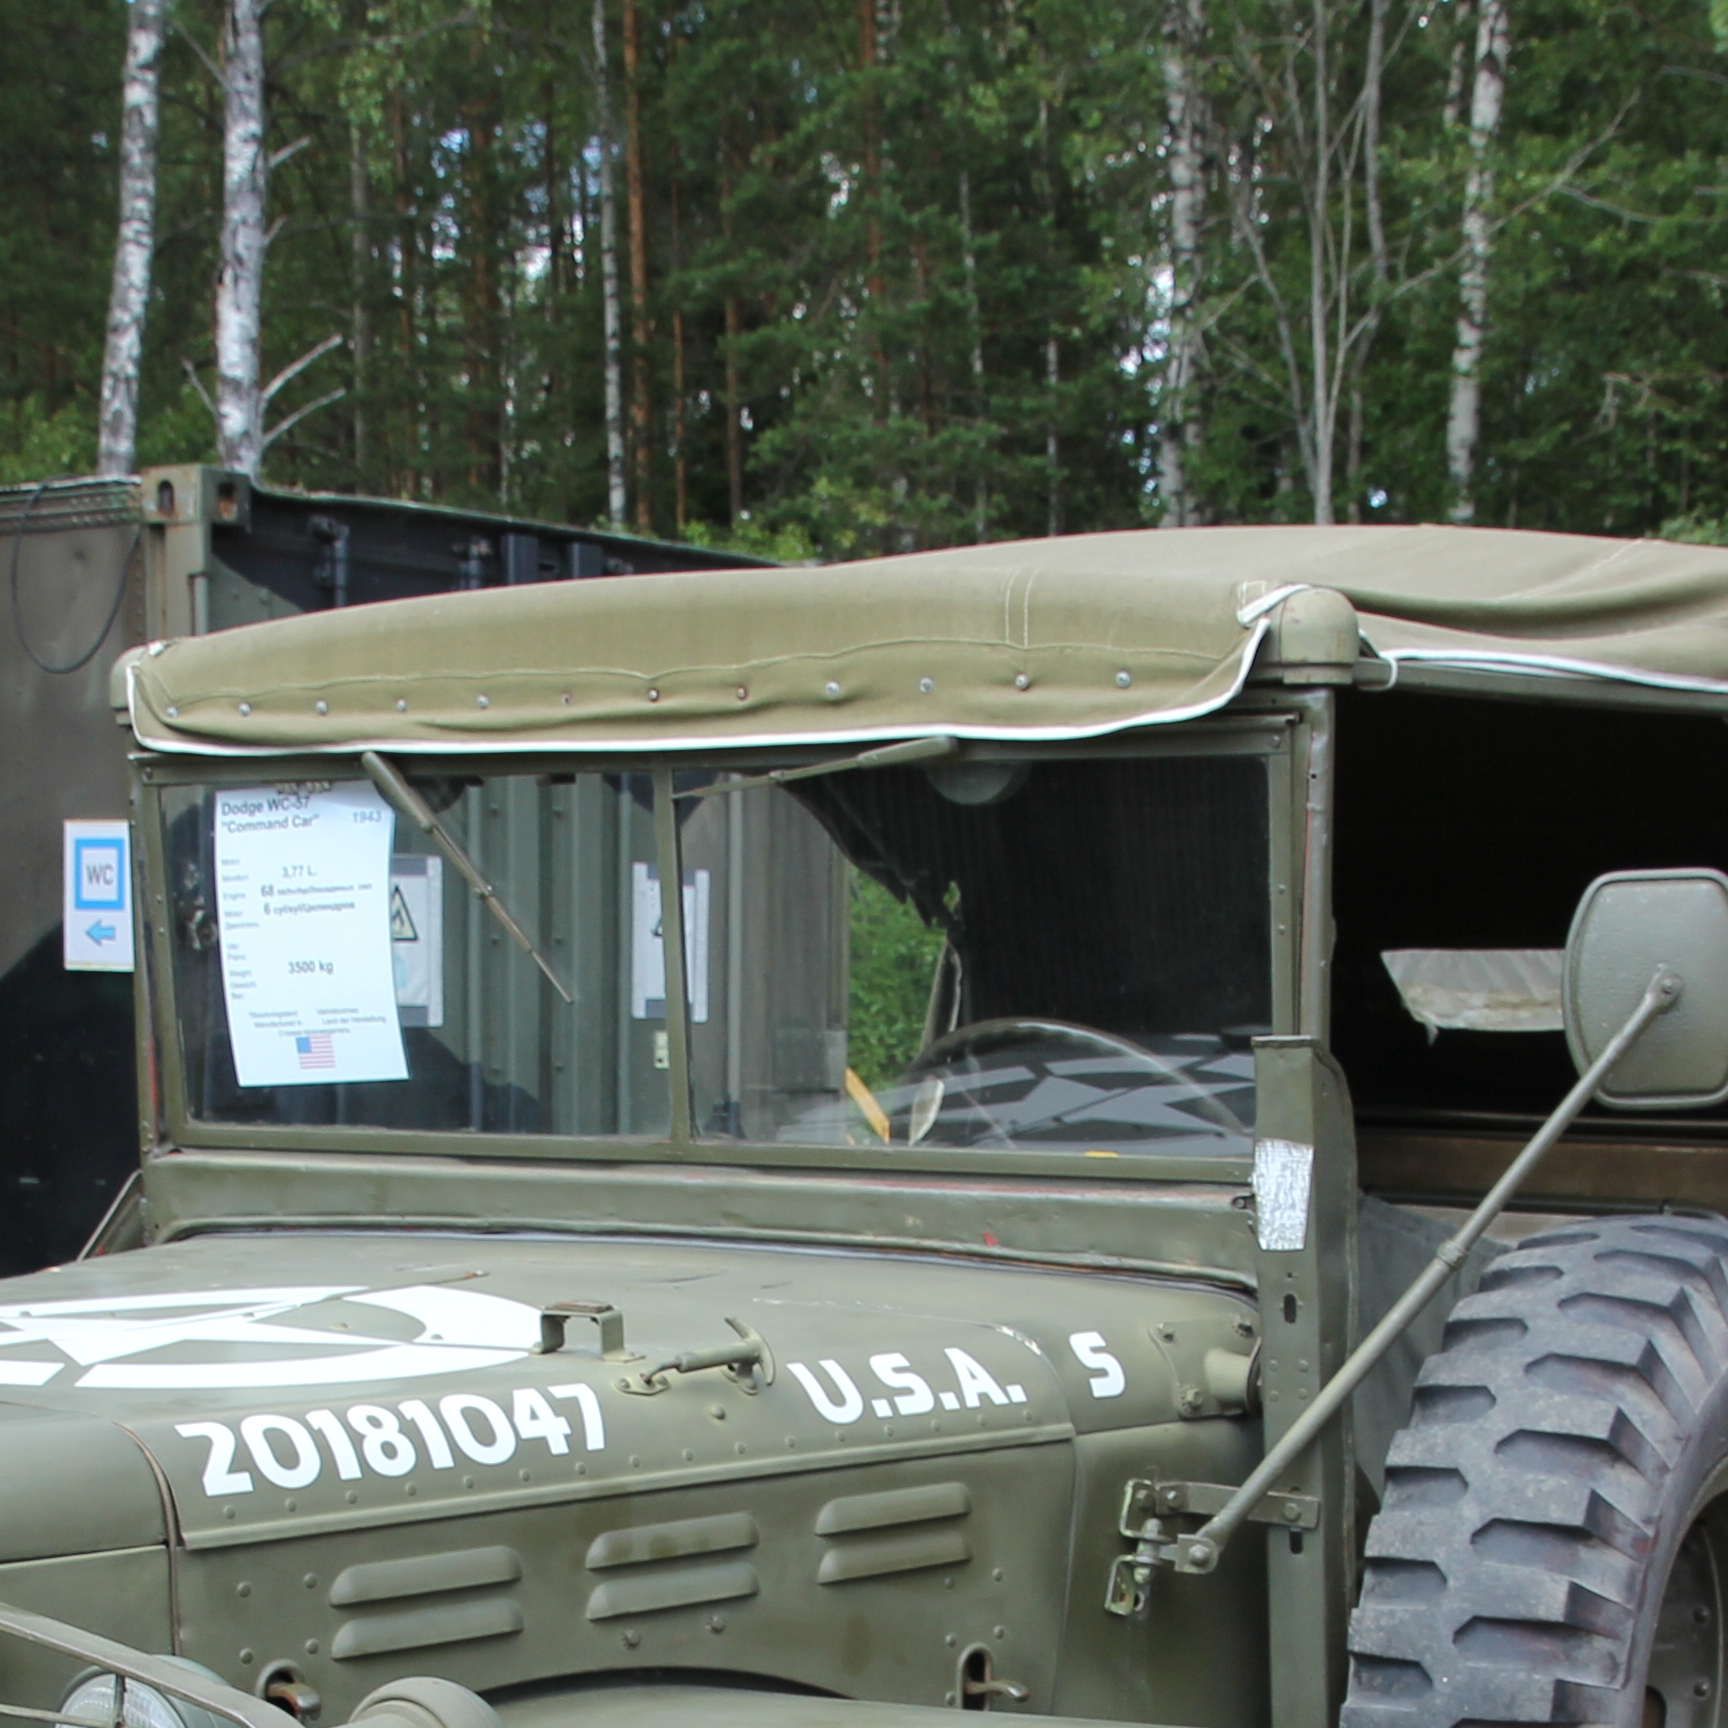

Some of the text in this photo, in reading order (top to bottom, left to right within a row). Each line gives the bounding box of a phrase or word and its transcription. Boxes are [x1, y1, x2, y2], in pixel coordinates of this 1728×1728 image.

[221, 798, 264, 817] Dodge
[352, 809, 382, 825] 1943
[221, 813, 321, 834] "Command Car"
[86, 863, 115, 887] WC
[260, 884, 275, 898] 68
[263, 902, 271, 916] 6
[287, 959, 334, 975] 3500 kg
[785, 1330, 1127, 1426] U.S.A. S
[173, 1382, 608, 1498] 20181047
